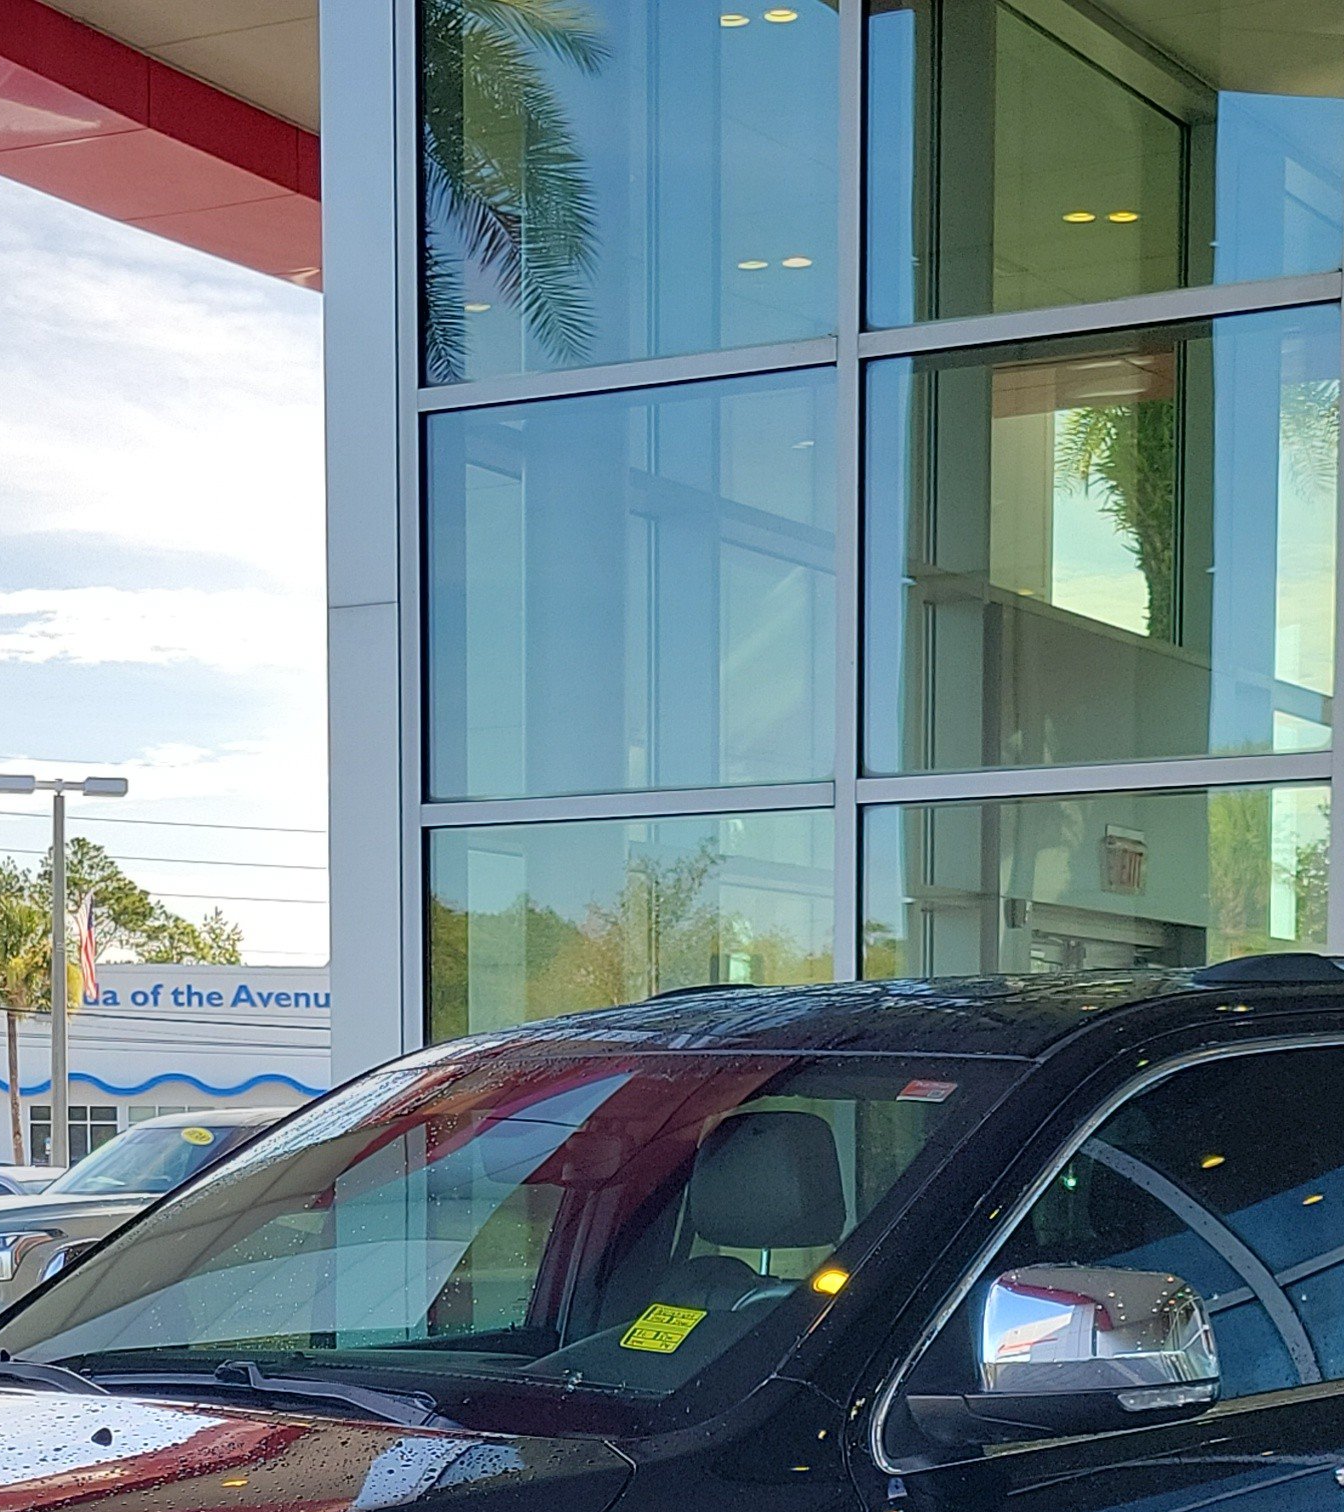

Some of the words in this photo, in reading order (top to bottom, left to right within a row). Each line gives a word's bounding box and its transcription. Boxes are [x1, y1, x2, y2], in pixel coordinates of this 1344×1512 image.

[130, 984, 164, 1008] of
[171, 984, 224, 1008] the
[230, 984, 331, 1009] Avenu
